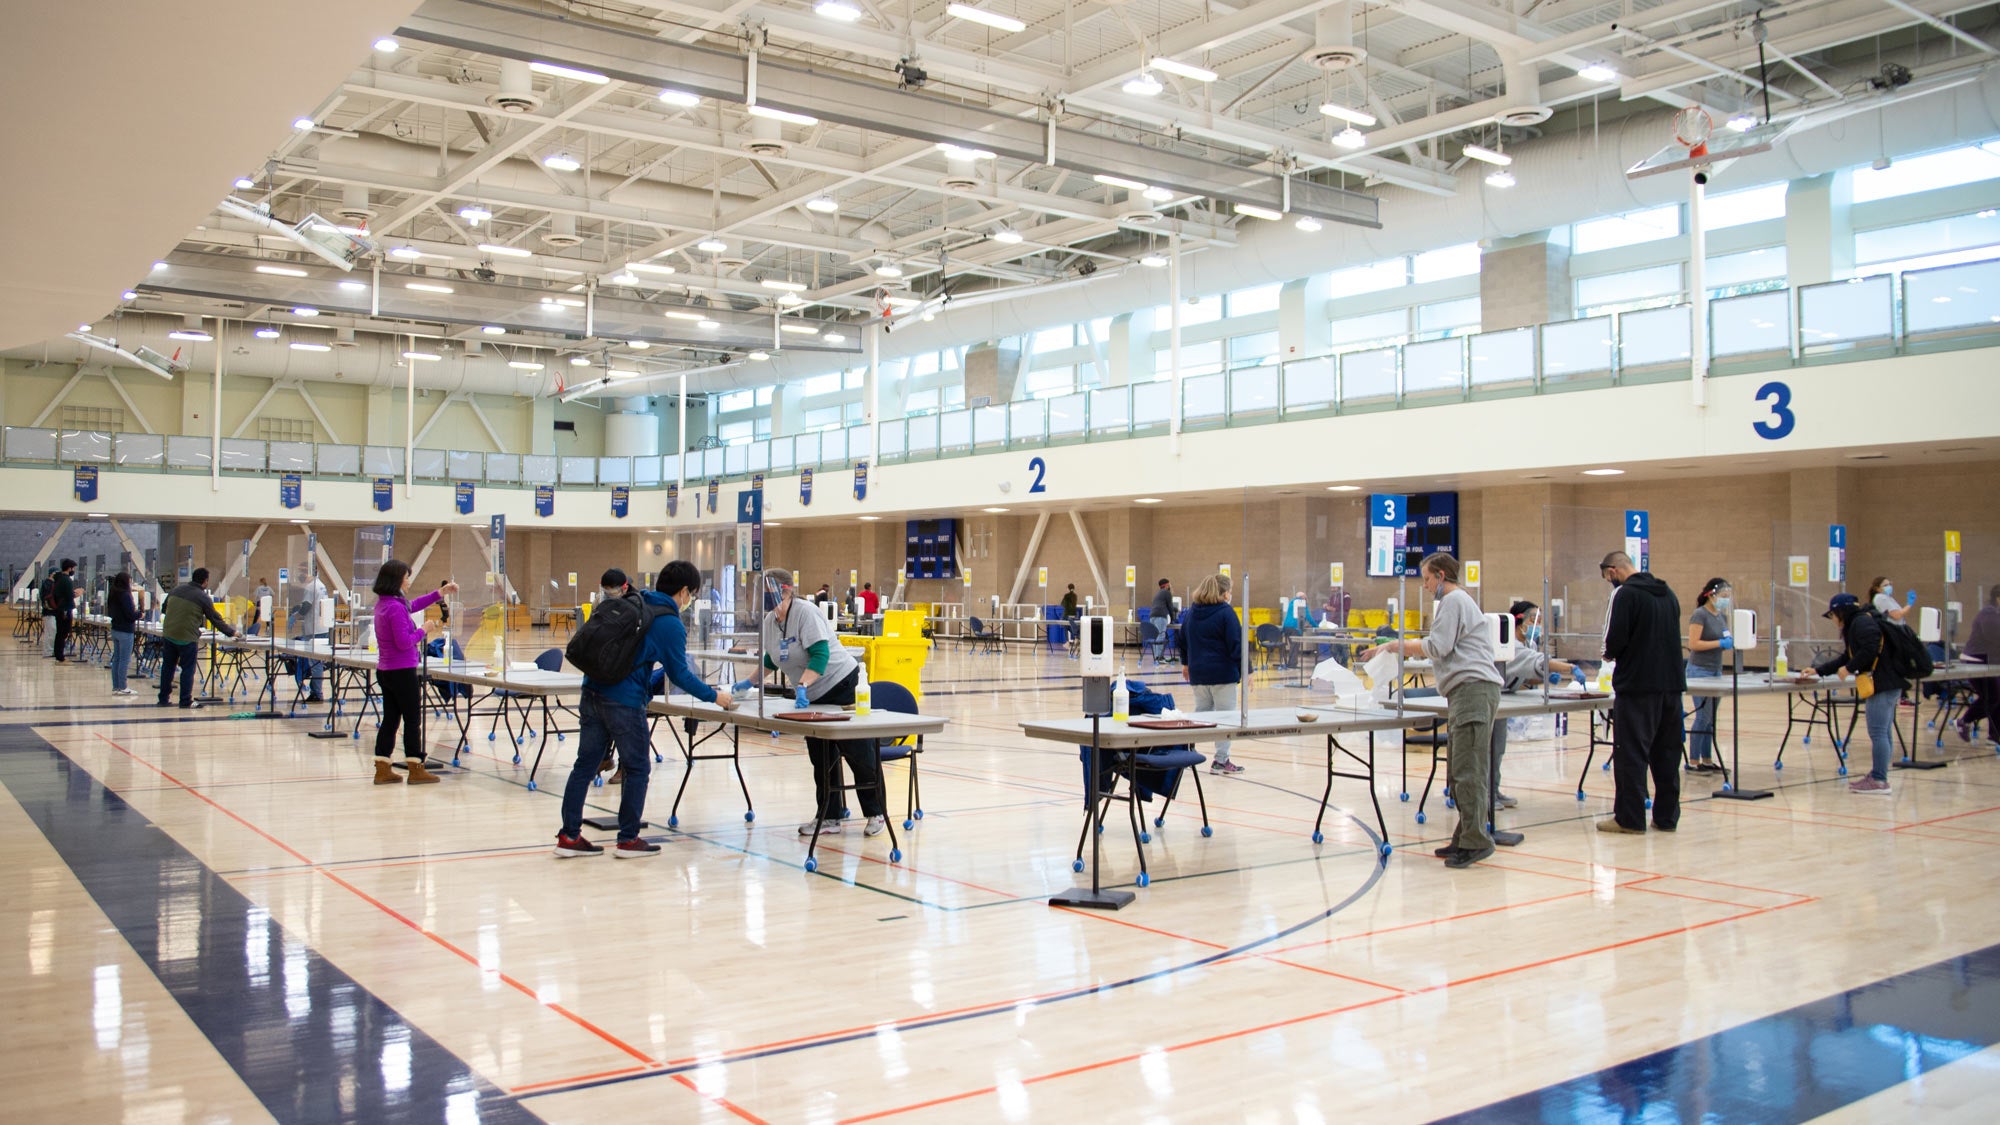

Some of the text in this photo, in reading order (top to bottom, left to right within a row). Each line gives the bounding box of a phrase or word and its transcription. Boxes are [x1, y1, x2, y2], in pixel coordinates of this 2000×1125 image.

[1752, 381, 1796, 440] 3
[1028, 456, 1046, 494] 2
[745, 495, 754, 516] 4
[1383, 499, 1396, 521] 3
[495, 518, 501, 534] 5
[1427, 515, 1450, 525] GUEST
[1632, 514, 1642, 533] 2
[1834, 528, 1840, 544] 1
[1950, 534, 1956, 548] 1
[1469, 567, 1476, 578] 7
[1795, 565, 1805, 577] 5
